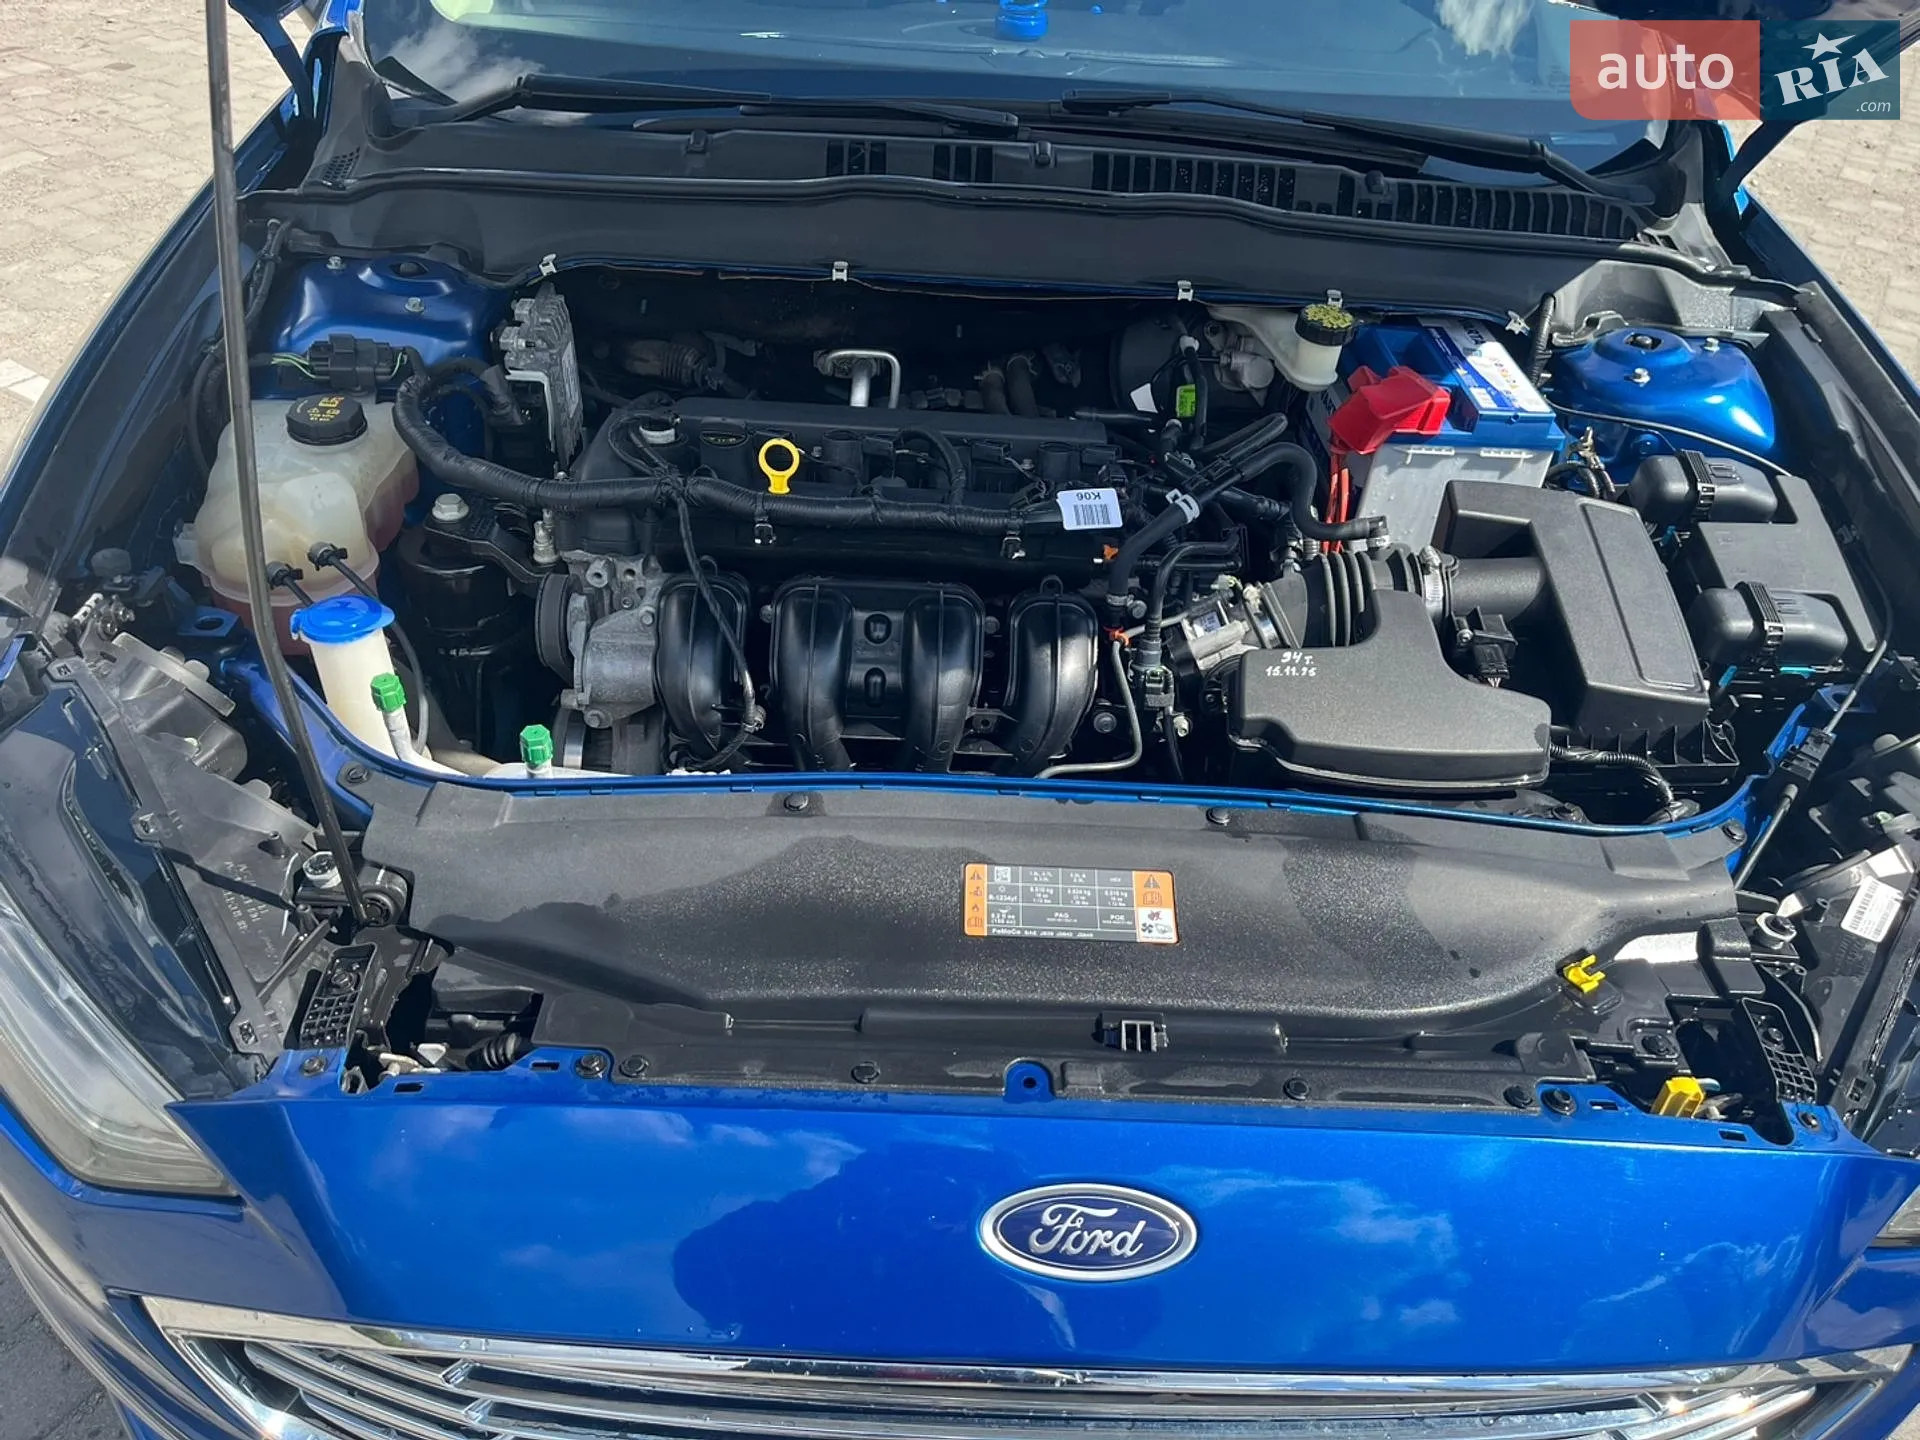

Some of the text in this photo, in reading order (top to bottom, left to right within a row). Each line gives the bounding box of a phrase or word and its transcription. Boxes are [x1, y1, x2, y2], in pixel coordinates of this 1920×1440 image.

[1076, 491, 1101, 500] K06
[1280, 651, 1302, 663] 94
[1029, 1203, 1147, 1258] Ford
